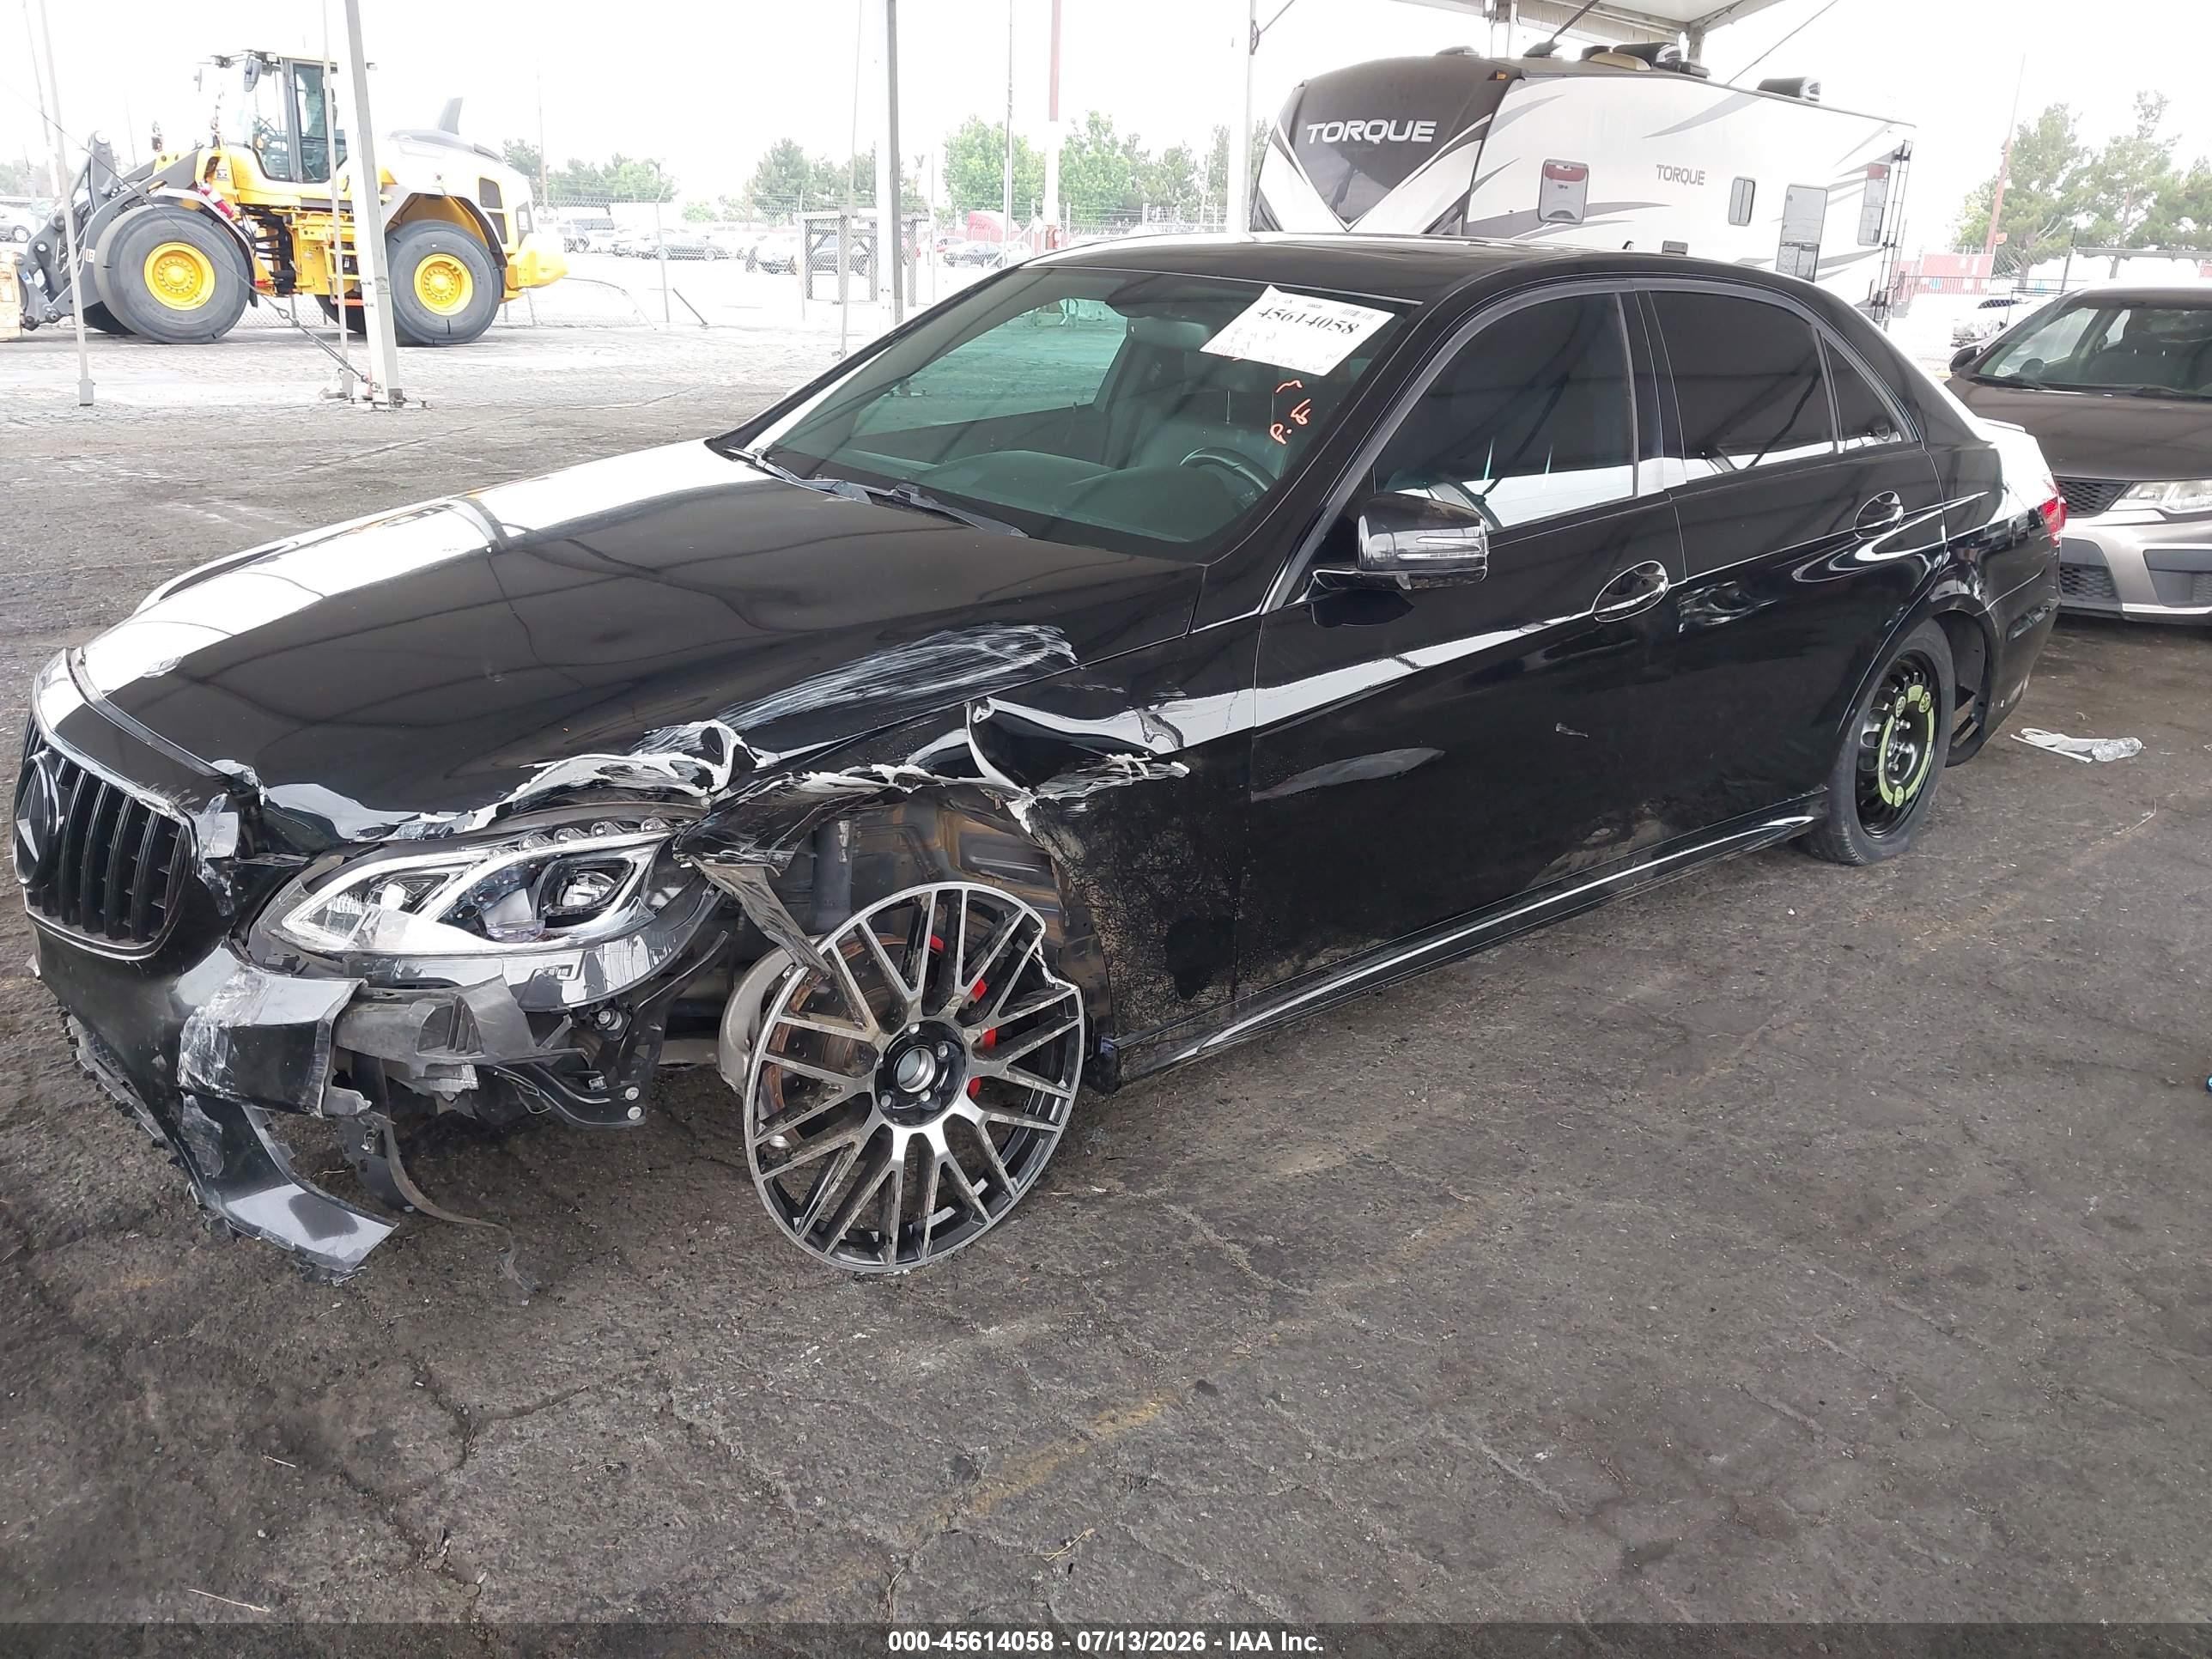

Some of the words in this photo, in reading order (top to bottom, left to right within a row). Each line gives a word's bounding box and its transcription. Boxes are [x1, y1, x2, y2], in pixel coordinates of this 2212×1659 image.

[1306, 119, 1437, 144] TORQUE
[1656, 163, 1705, 185] TORQUE
[1257, 307, 1359, 335] 45614058
